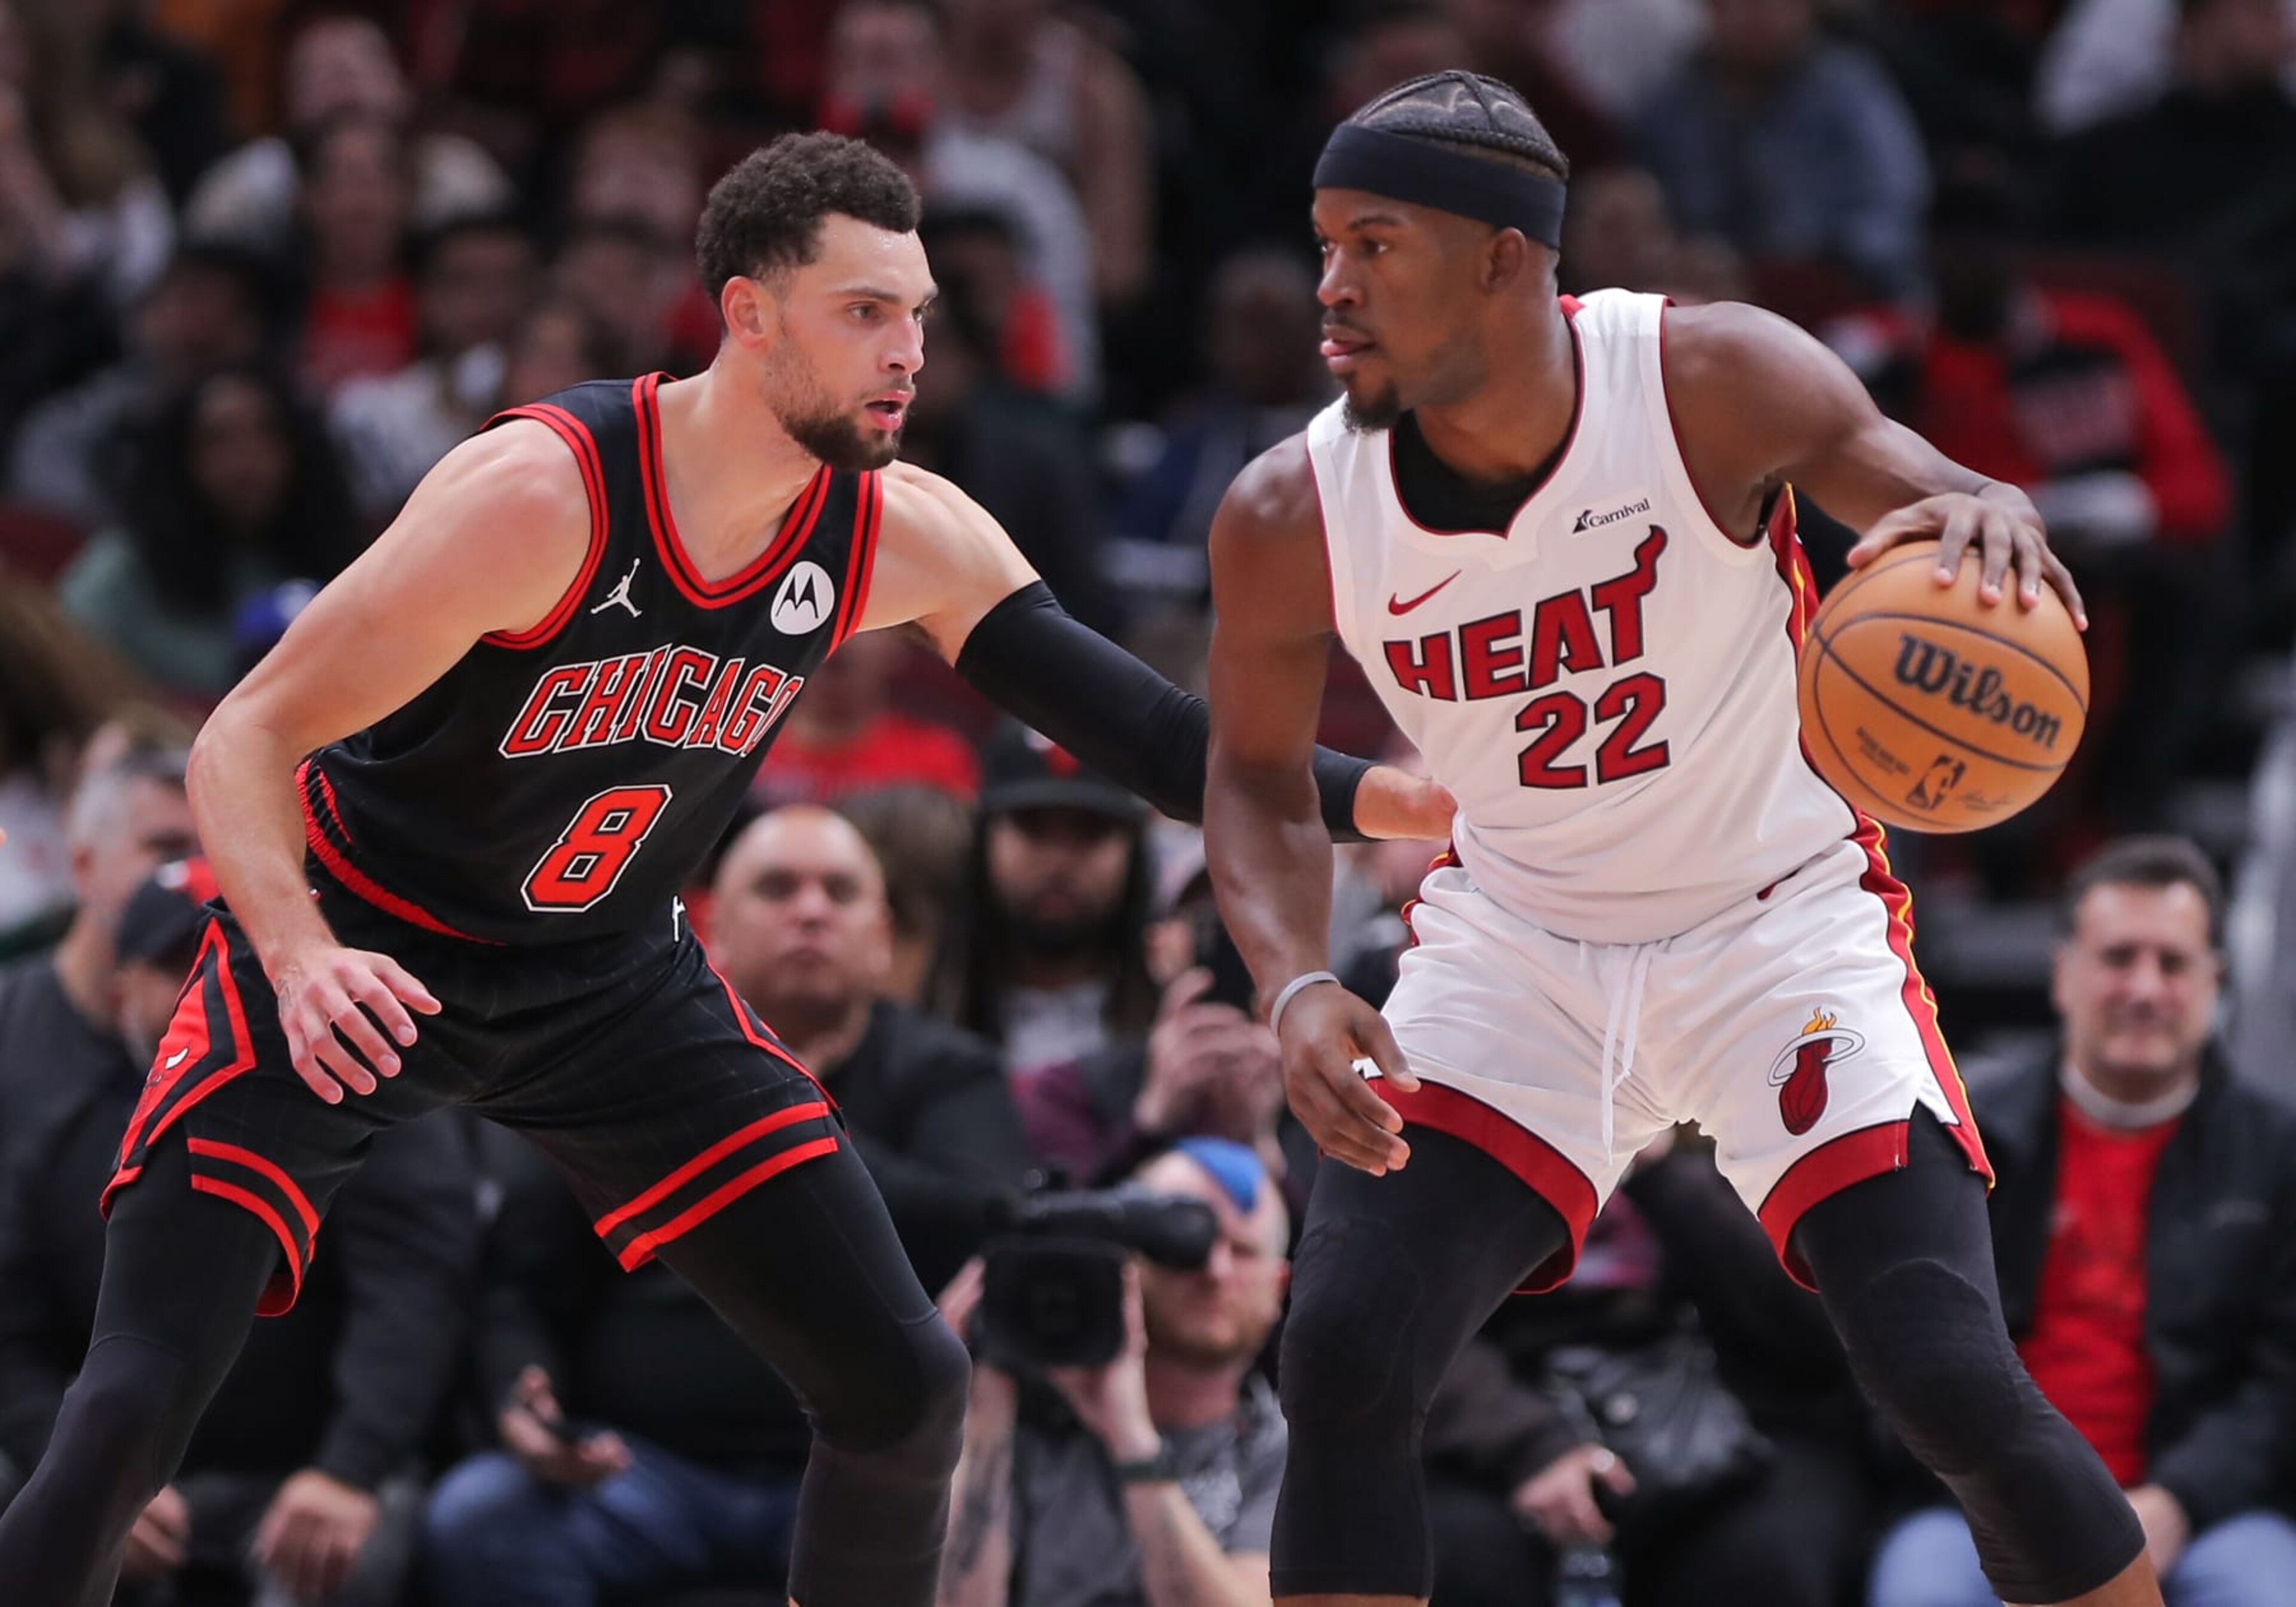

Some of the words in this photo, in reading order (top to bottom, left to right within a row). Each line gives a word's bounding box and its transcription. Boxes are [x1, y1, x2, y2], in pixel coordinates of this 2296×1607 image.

[1589, 499, 1650, 527] Carnival
[1383, 524, 1668, 702] HEAT
[499, 643, 804, 759] CHICAGO
[1515, 672, 1670, 789] 22
[1896, 634, 2061, 749] Wilson
[521, 784, 672, 912] 8
